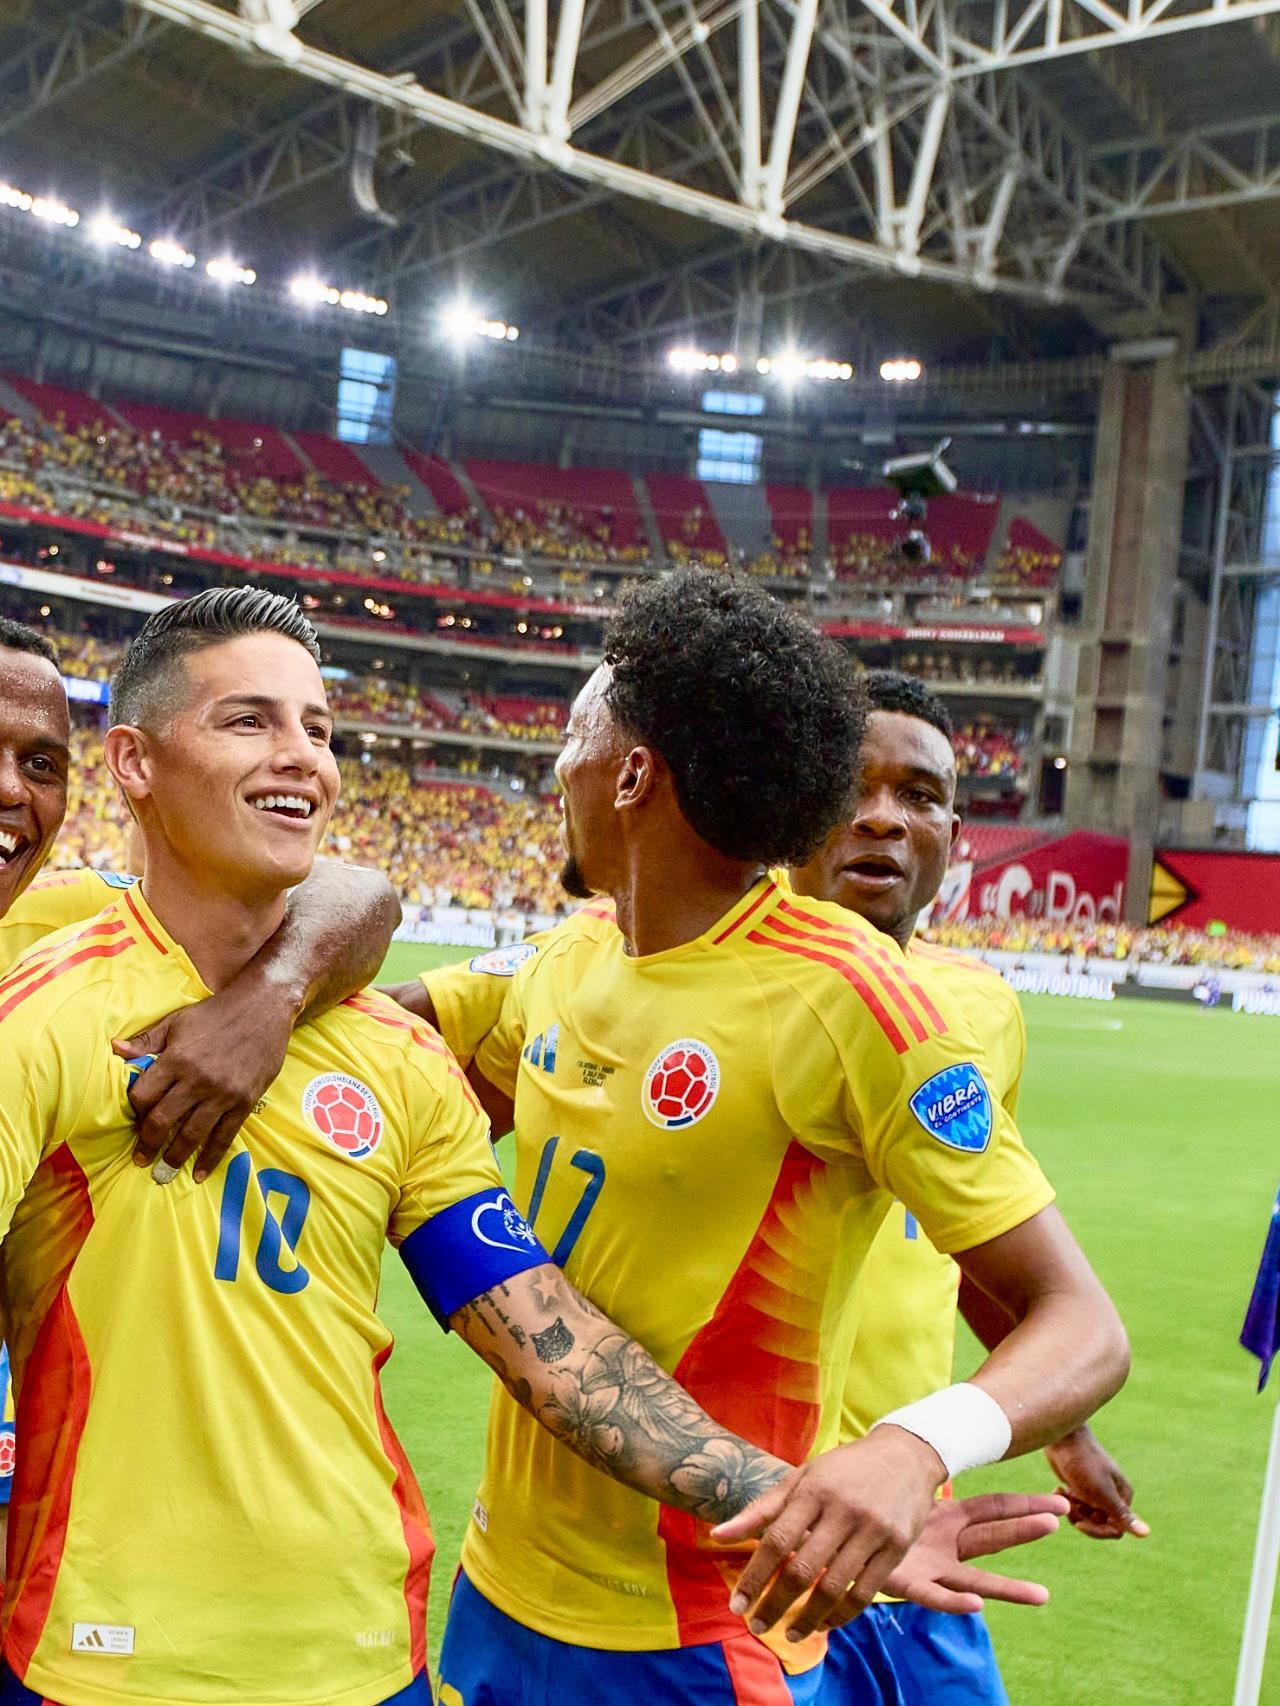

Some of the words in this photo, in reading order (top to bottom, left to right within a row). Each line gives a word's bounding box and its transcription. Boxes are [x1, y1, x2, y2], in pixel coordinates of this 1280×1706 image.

[927, 1080, 979, 1122] VIBRA
[214, 1150, 311, 1294] 10
[525, 1135, 607, 1270] 17
